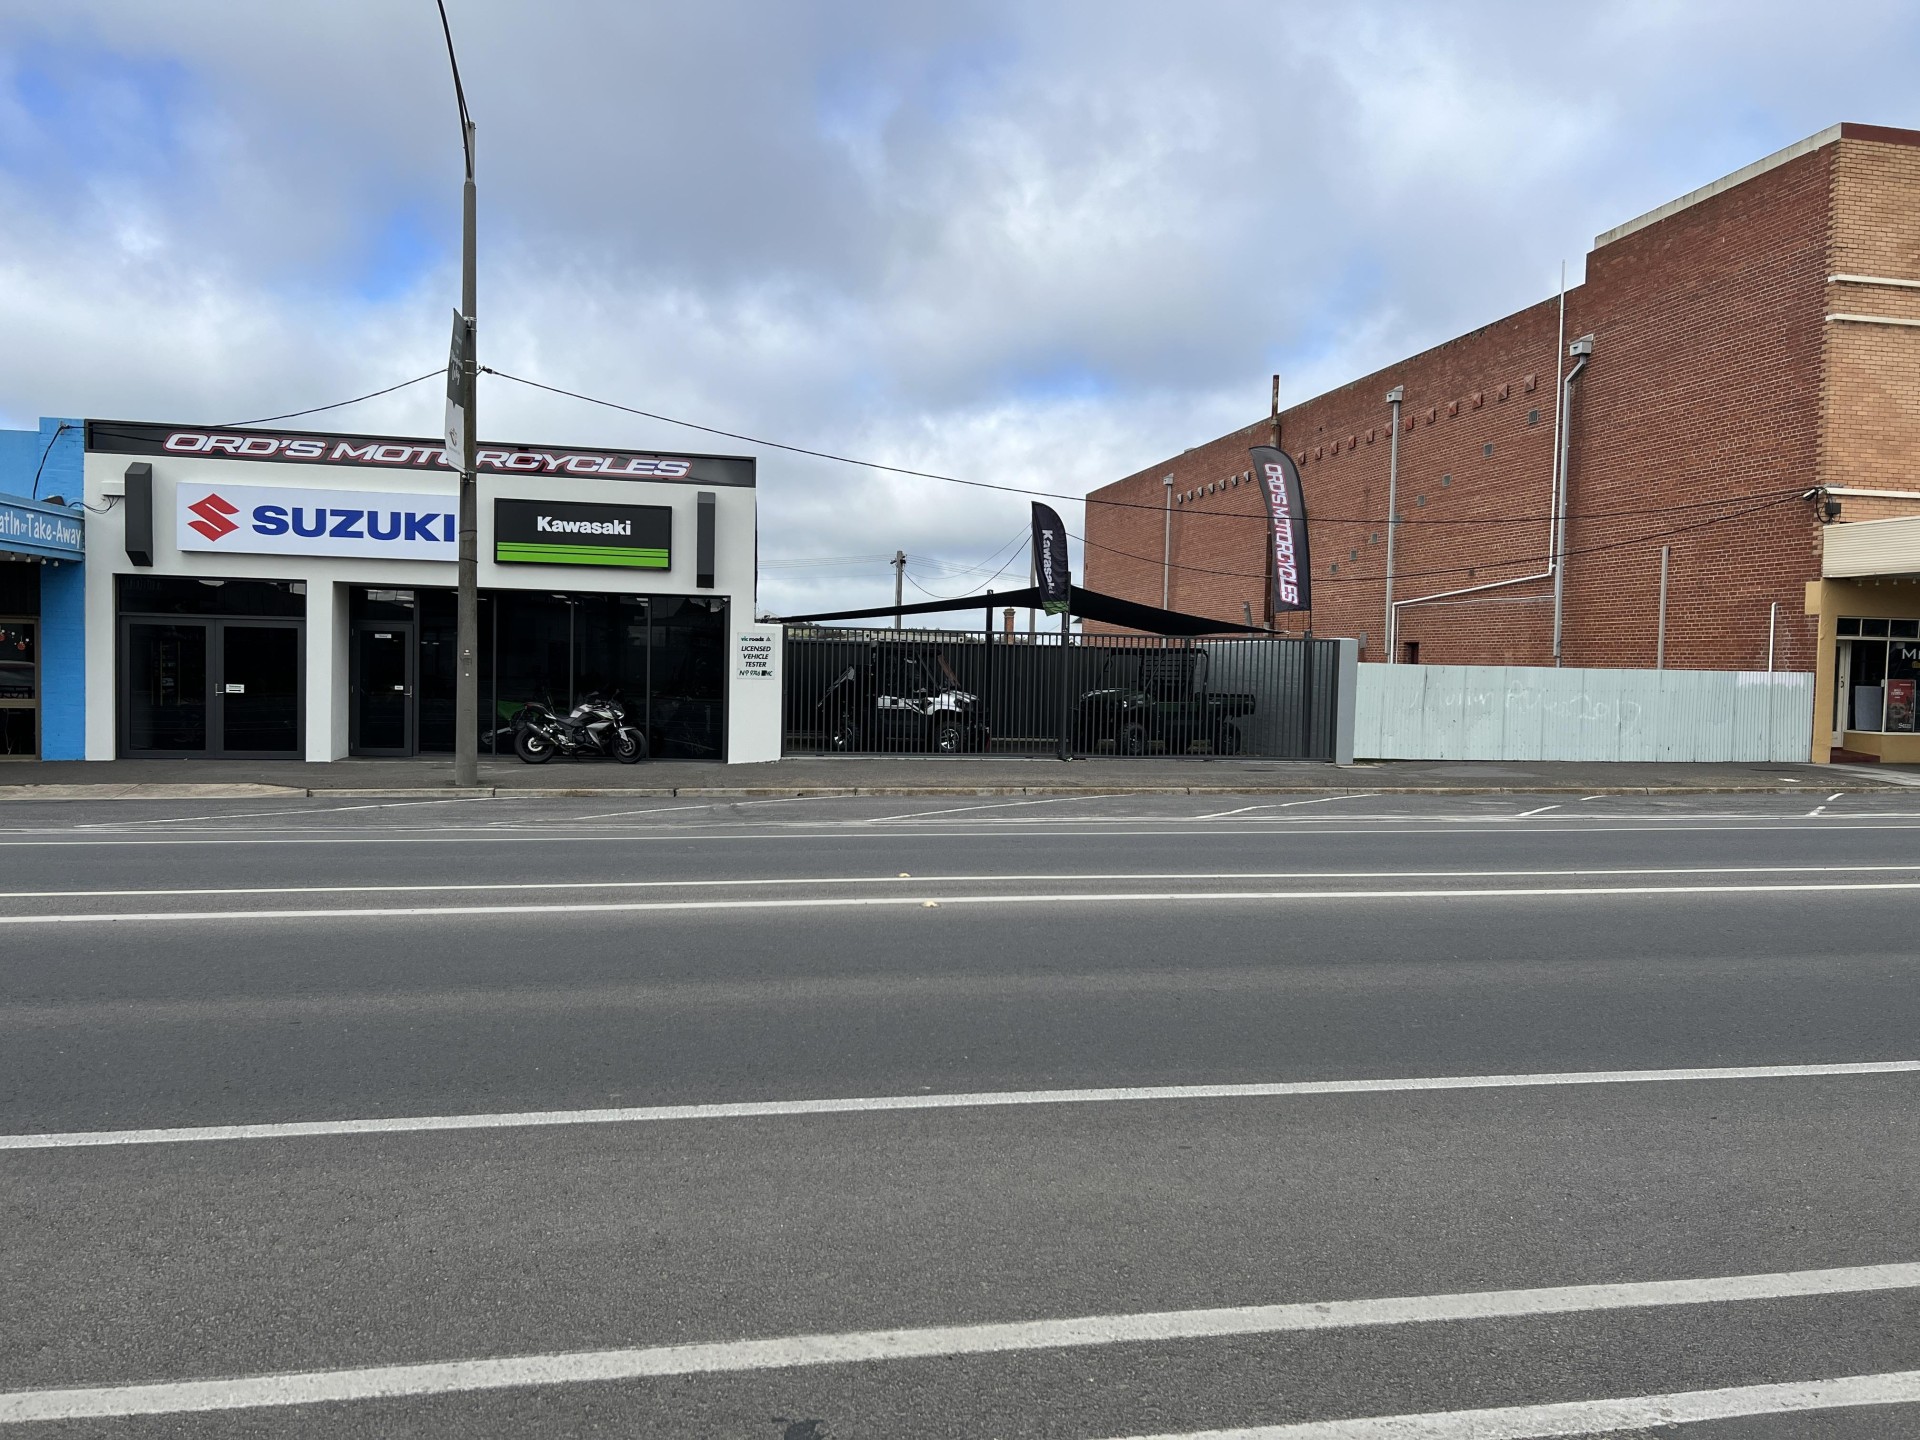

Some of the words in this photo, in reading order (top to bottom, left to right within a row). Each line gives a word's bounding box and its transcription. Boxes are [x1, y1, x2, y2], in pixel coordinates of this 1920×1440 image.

[164, 432, 326, 459] ORD'S
[331, 441, 691, 478] MOTRCYCLES
[1264, 463, 1288, 505] ORD'S
[252, 504, 456, 542] SUZUKI
[537, 516, 632, 536] Kawasaki
[1041, 529, 1056, 594] Kawasaki
[1272, 503, 1299, 605] MOTORCYCLES
[1901, 648, 1920, 660] M
